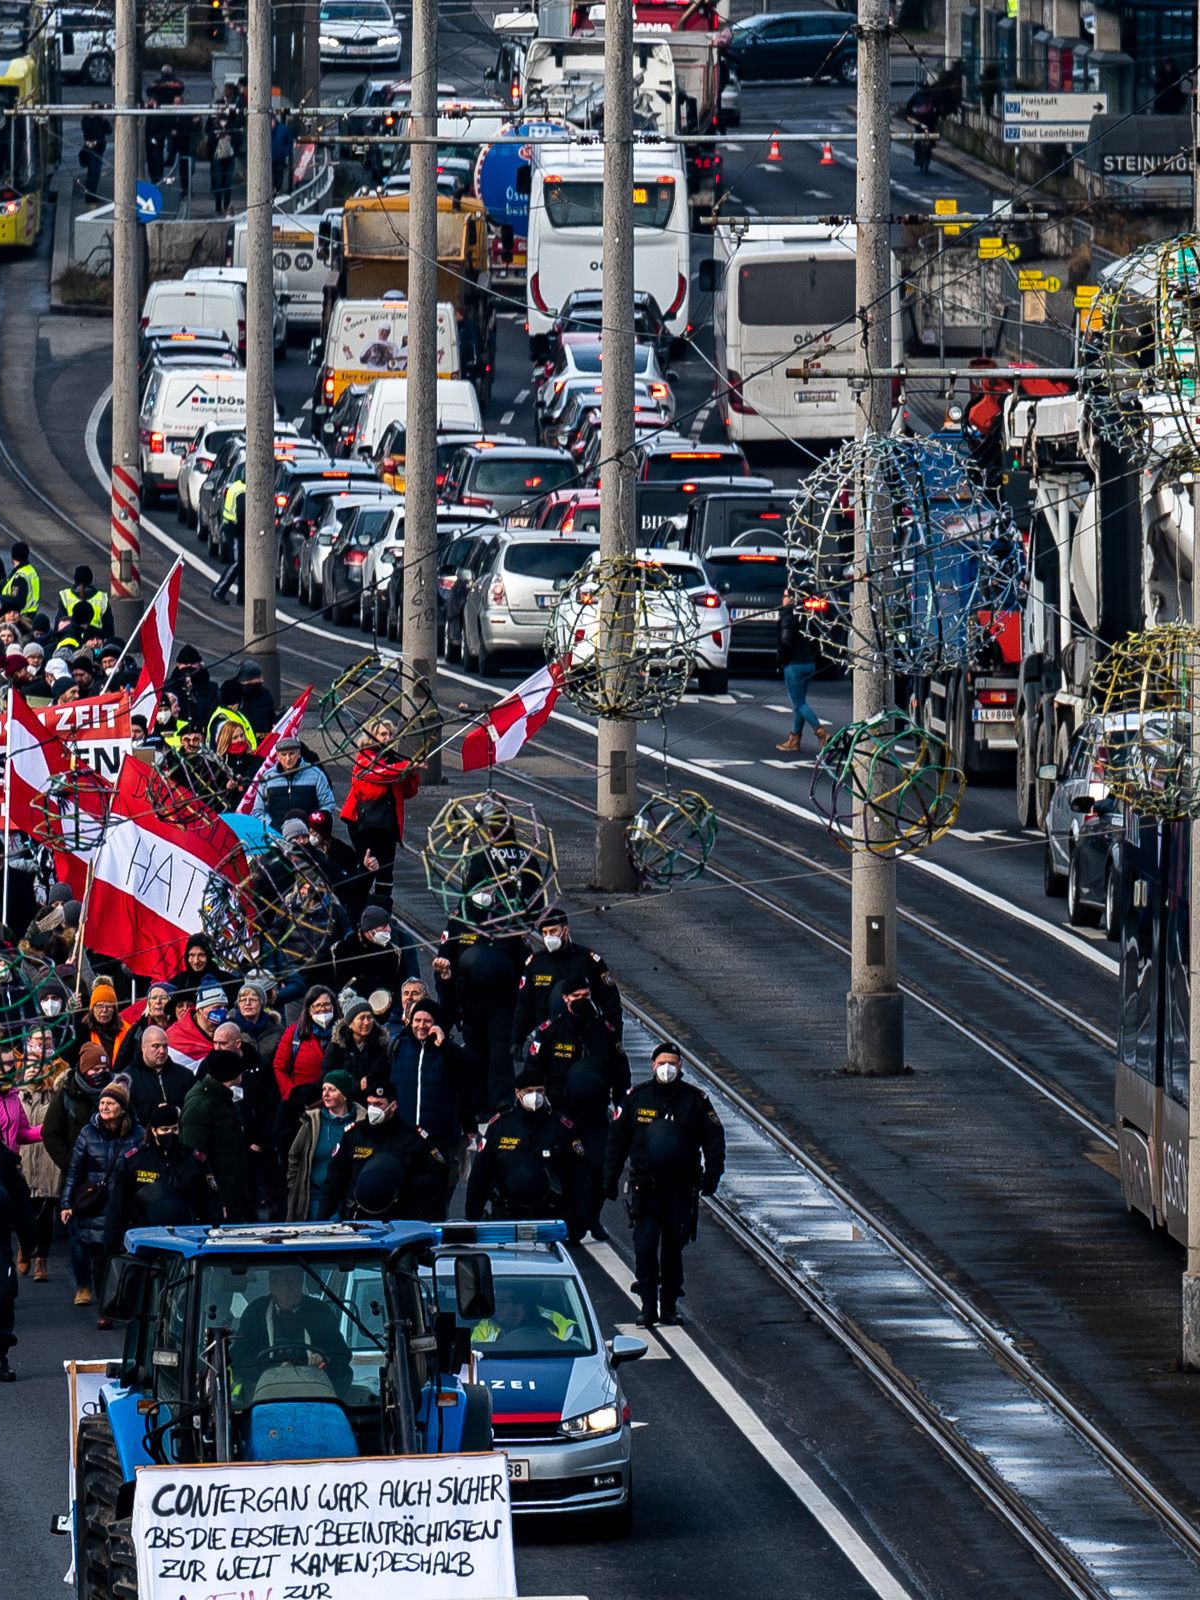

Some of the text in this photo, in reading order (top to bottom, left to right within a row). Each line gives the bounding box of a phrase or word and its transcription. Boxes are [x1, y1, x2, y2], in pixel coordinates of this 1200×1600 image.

[55, 703, 119, 731] ZEIT
[126, 836, 209, 918] HAT
[479, 1380, 536, 1390] IZEI
[151, 1473, 506, 1518] CONTERGAN WAR AUCH SICHER
[144, 1514, 503, 1551] BIS DIE ERSTEN BEEINTRÄCHTIGTEN
[158, 1558, 207, 1583] ZUR
[216, 1553, 281, 1582] WELT
[282, 1582, 333, 1599] ZUR
